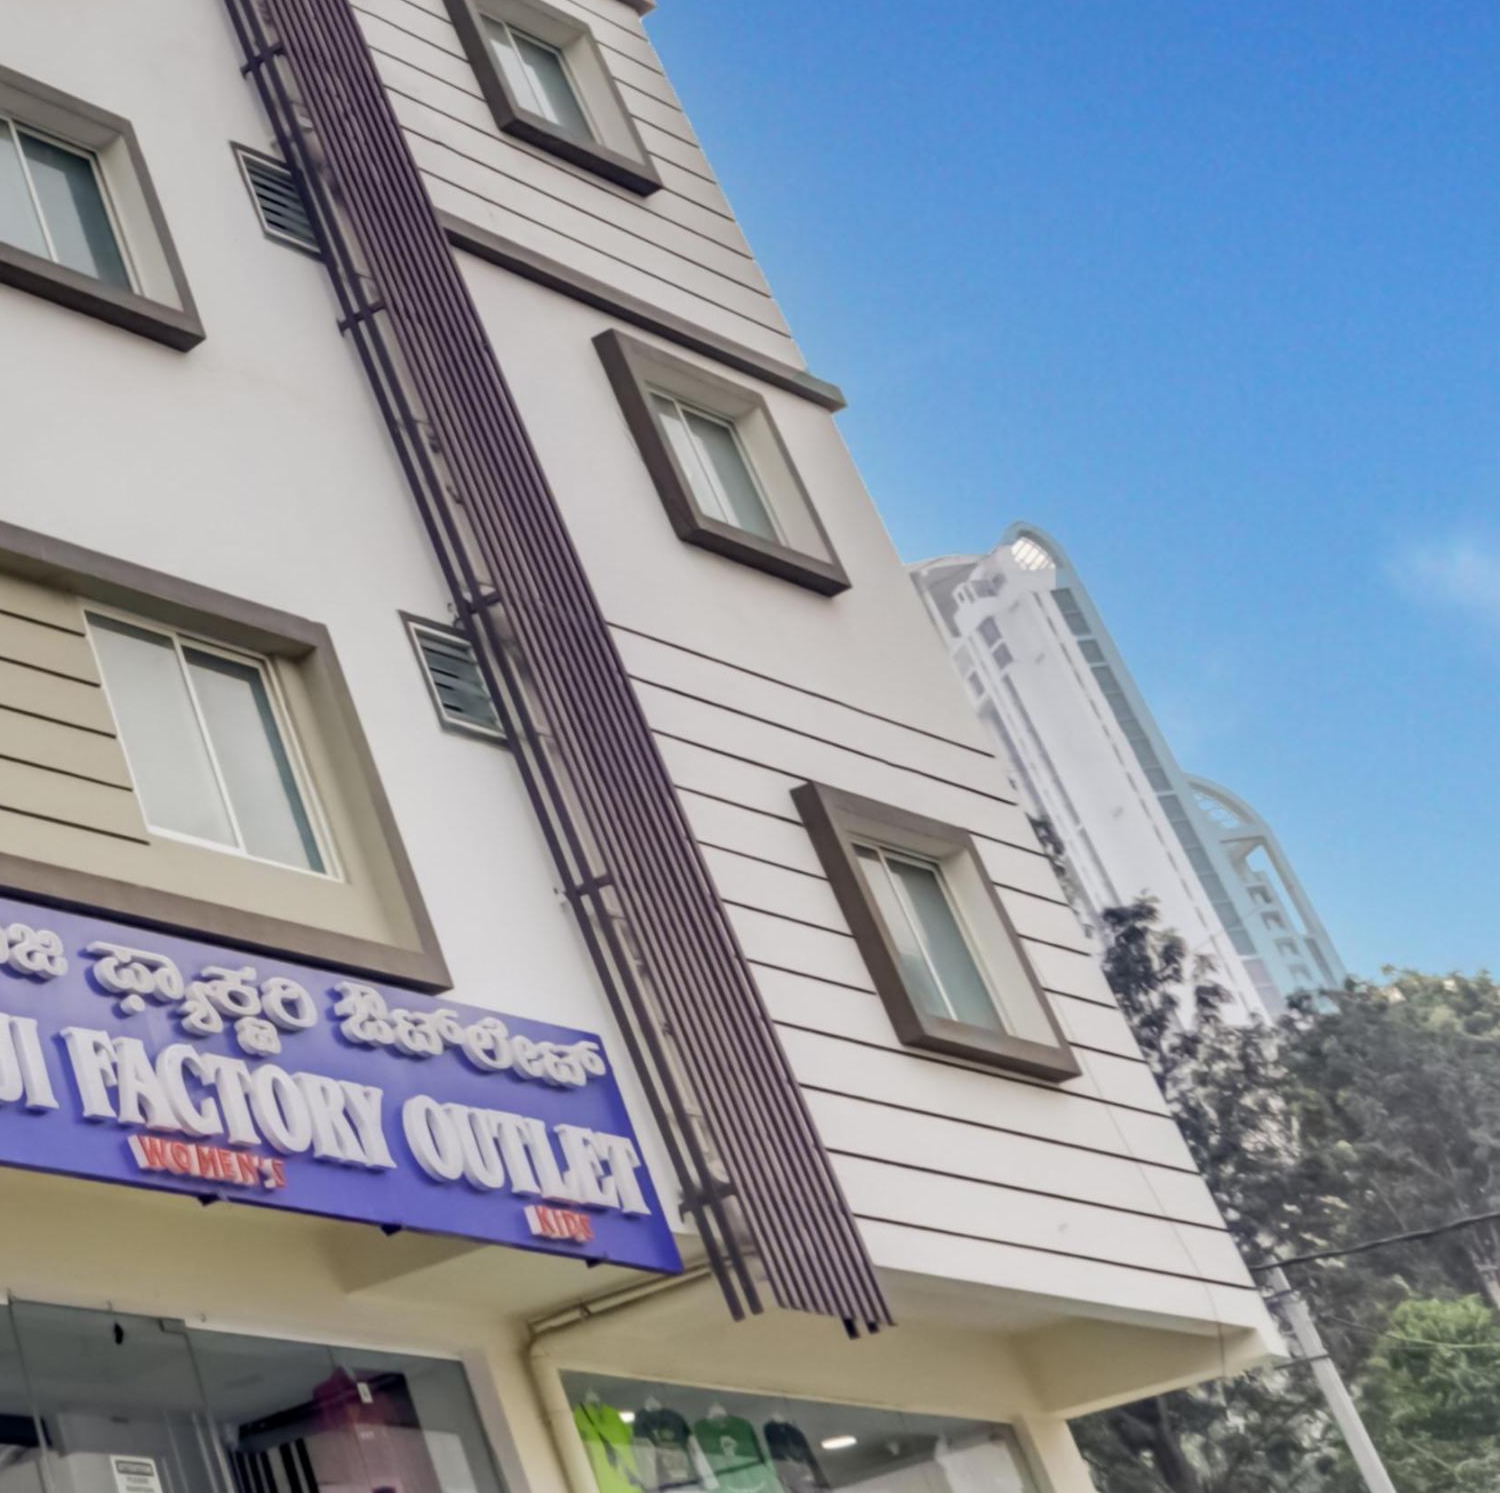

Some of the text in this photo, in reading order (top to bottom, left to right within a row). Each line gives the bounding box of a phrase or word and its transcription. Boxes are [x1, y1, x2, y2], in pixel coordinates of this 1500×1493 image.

[60, 1025, 396, 1170] FACTORY
[403, 1094, 651, 1215] OUTLET
[128, 1134, 287, 1189] WOMEN'S
